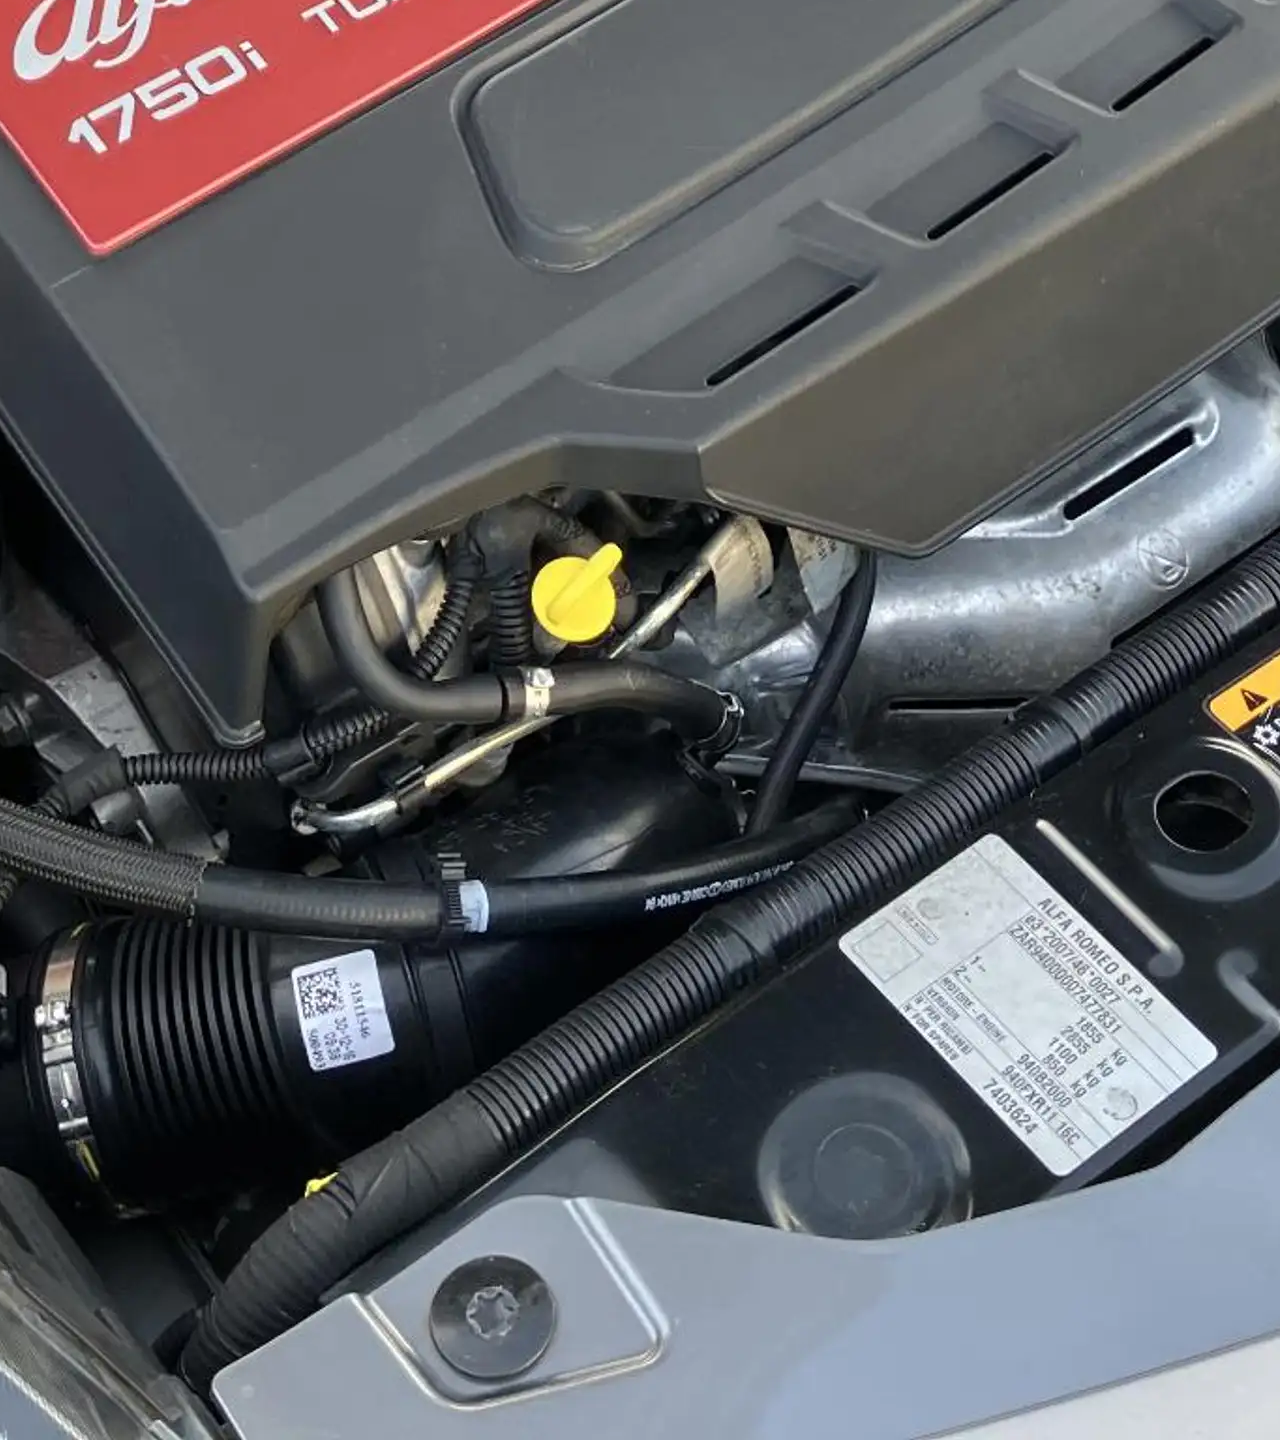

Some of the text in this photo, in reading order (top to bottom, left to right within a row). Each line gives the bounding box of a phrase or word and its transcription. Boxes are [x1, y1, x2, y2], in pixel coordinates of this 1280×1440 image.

[67, 40, 268, 155] 1750i
[1036, 895, 1158, 1015] ALFA ROMEO S.P.A.
[1047, 1035, 1078, 1066] 1100
[1081, 1068, 1101, 1089] kg
[1059, 1024, 1115, 1079] 2855 kg
[1074, 1015, 1128, 1068] 1855 kg
[1041, 1053, 1066, 1077] 850
[1067, 1079, 1088, 1099] kg
[981, 1076, 1040, 1136] 7403624
